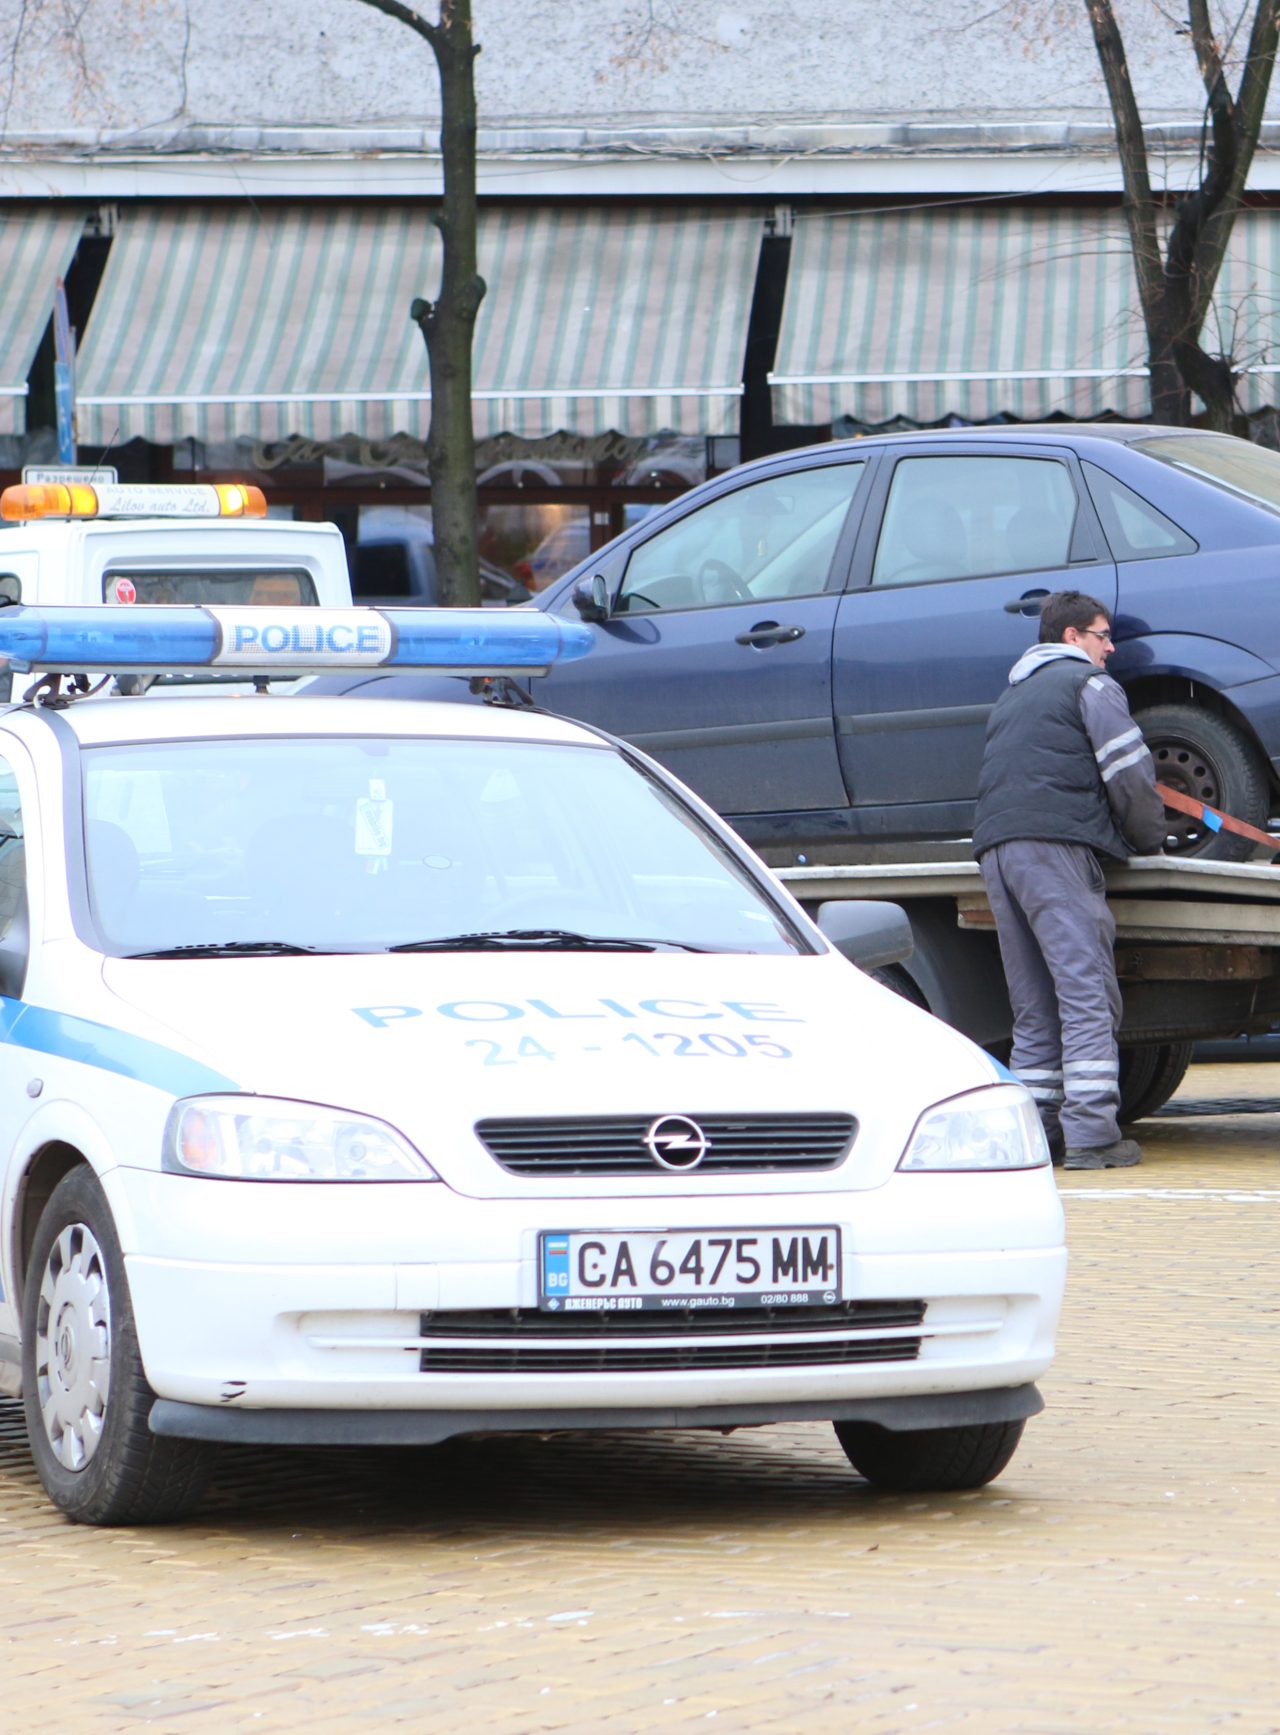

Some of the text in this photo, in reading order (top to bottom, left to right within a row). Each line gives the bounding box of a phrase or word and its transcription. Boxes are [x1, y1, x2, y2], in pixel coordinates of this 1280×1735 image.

[106, 486, 206, 495] AUTO SERVICE
[234, 624, 382, 652] POLICE
[348, 998, 807, 1029] POLICE
[649, 1238, 761, 1287] 6475
[548, 1272, 569, 1288] BG
[661, 1295, 735, 1308] www.gauto.bg
[760, 1293, 809, 1304] 02/80 888
